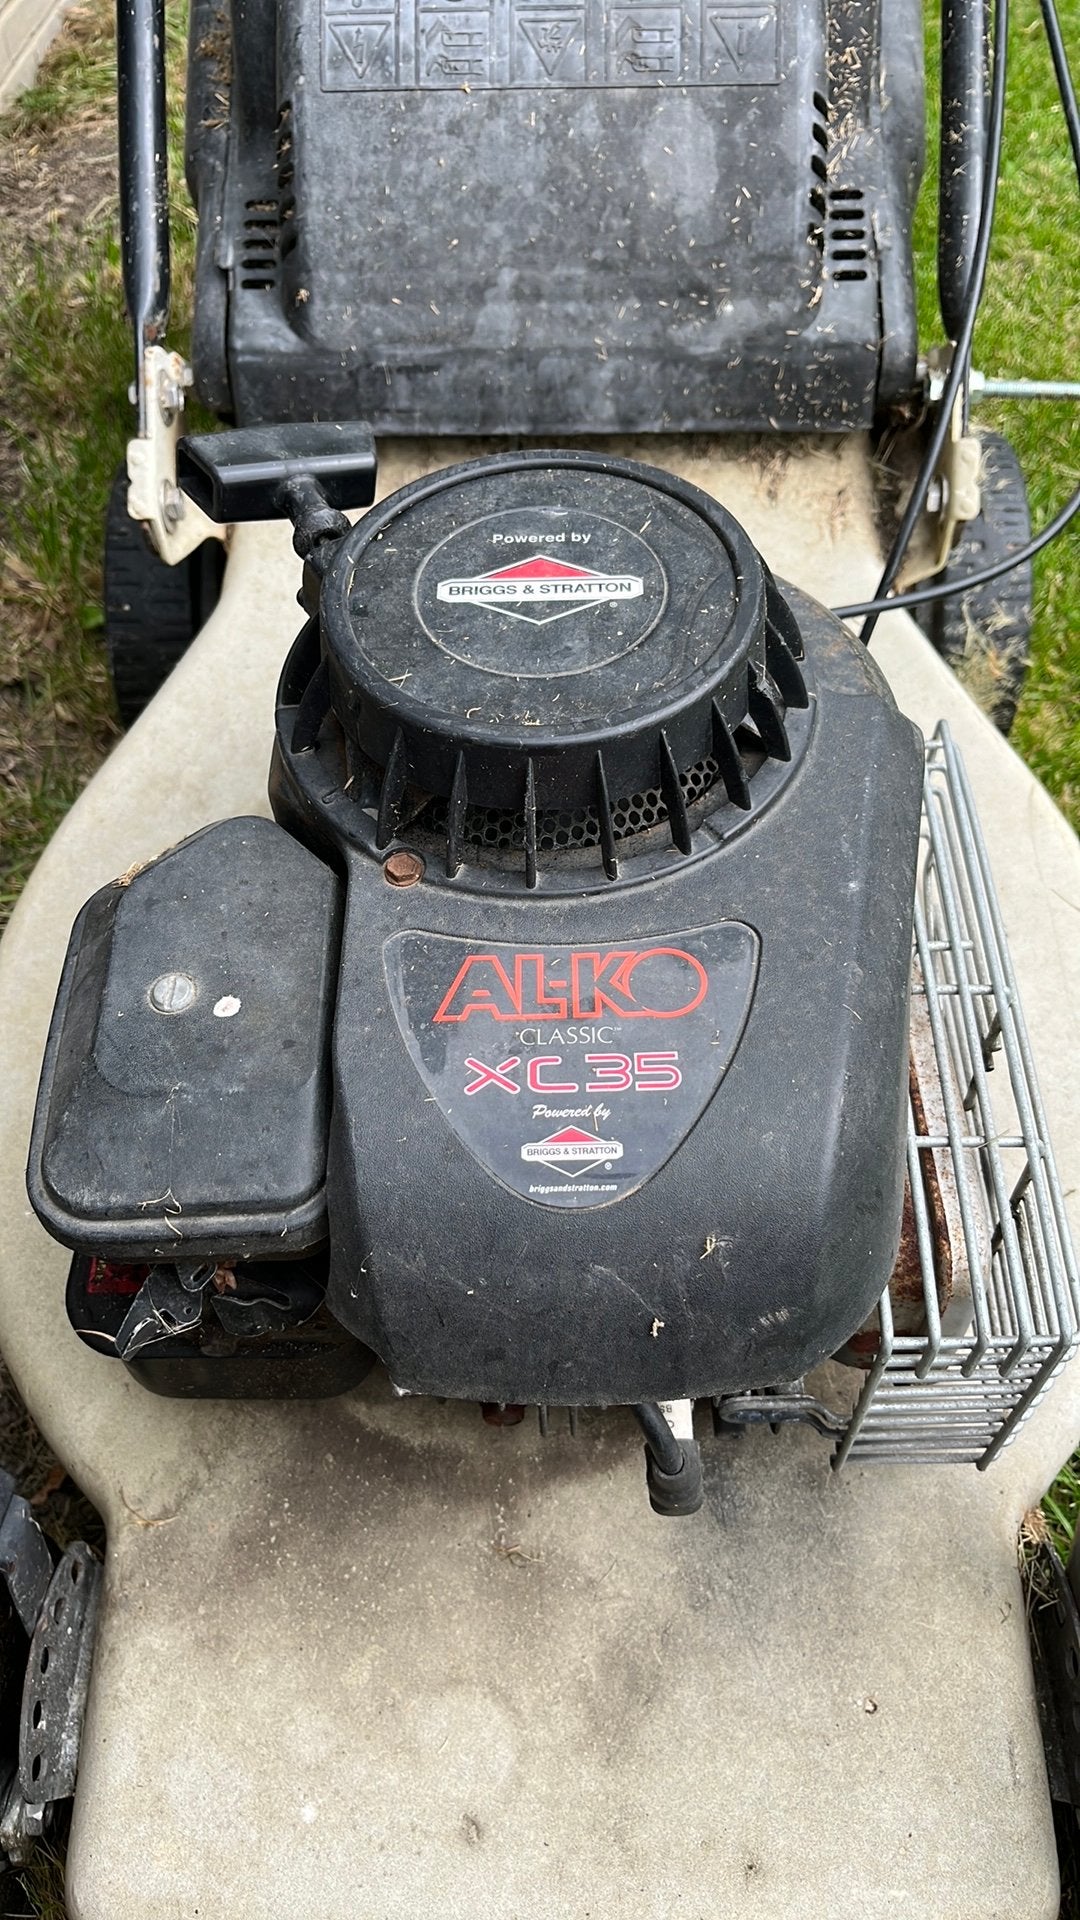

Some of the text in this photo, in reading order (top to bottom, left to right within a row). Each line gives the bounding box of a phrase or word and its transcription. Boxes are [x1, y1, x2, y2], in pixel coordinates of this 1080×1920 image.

[492, 532, 592, 544] Powered by
[448, 582, 632, 596] BRIGGS & STRATTON
[433, 947, 709, 1022] AL-KO
[532, 1102, 612, 1121] Powered by
[526, 1146, 618, 1156] BRIGGS & STRATTON
[528, 1183, 618, 1194] briggsandstratton.com
